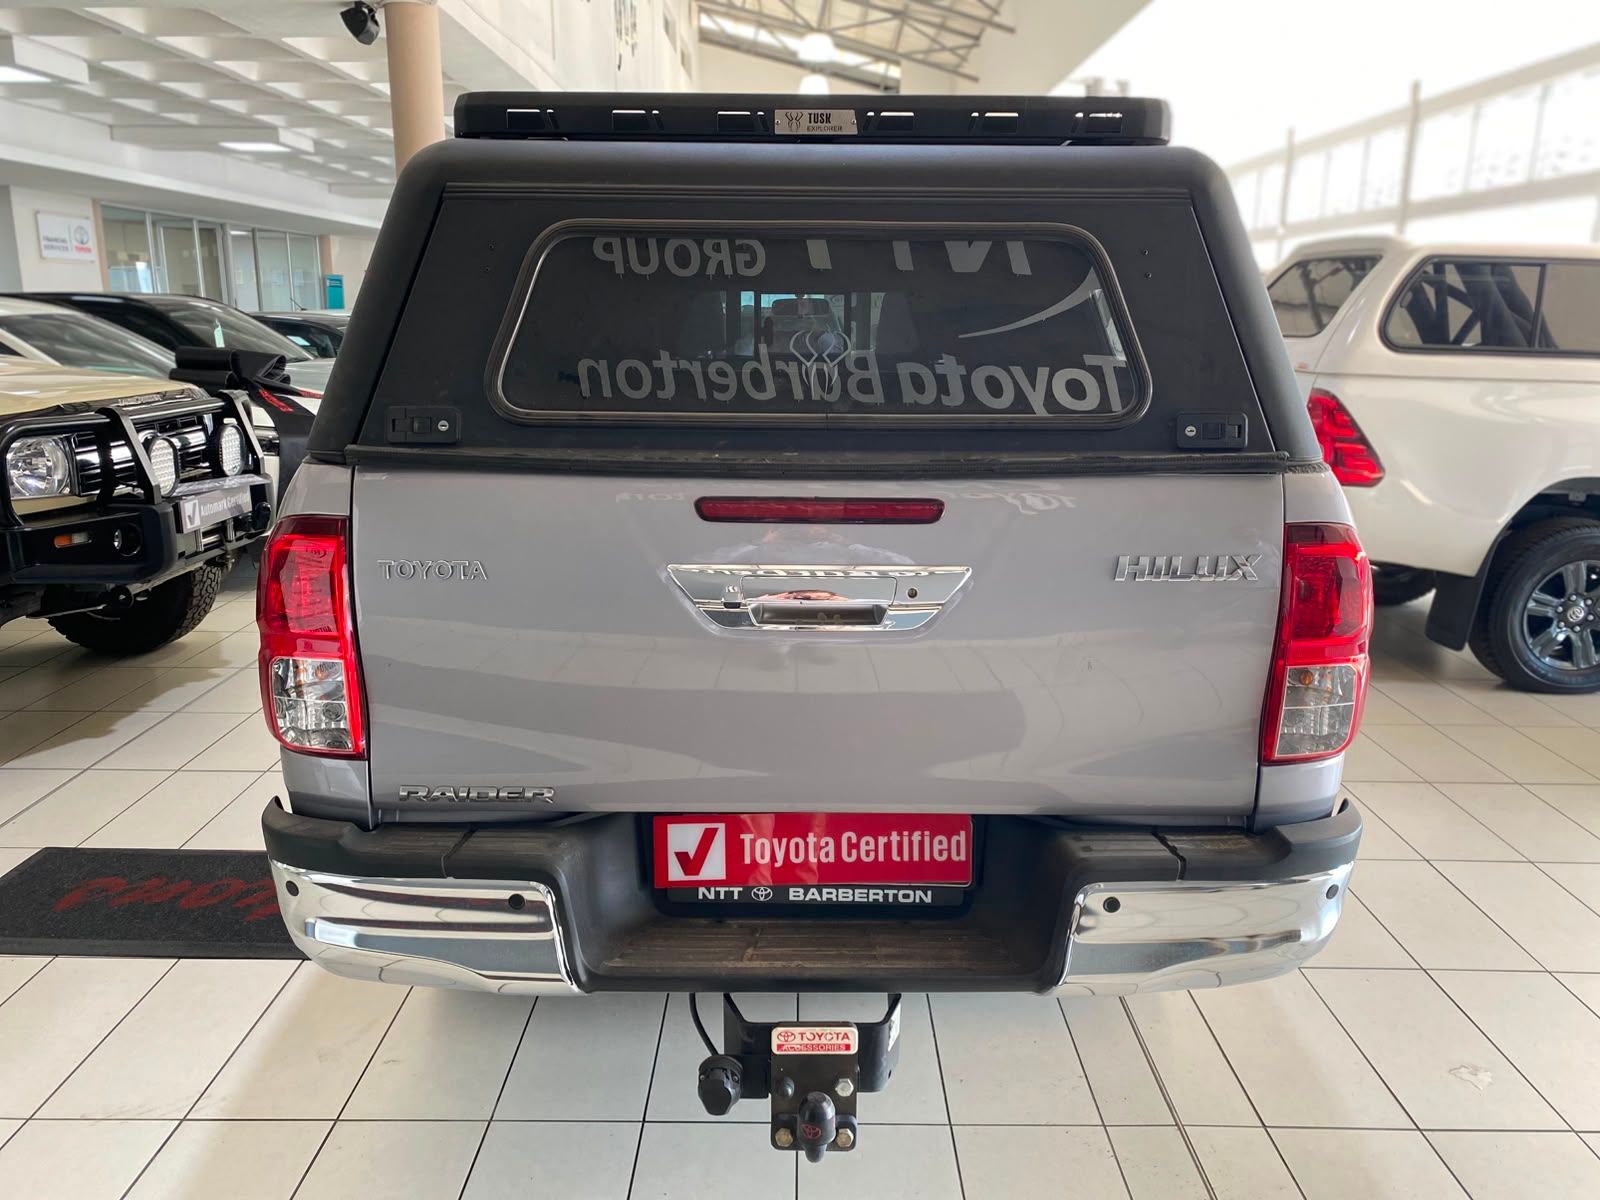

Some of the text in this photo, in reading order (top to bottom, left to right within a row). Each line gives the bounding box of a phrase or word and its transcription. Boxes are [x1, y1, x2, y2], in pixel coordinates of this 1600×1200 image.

[807, 112, 831, 124] TUSK
[376, 559, 488, 580] TOYOTA
[1114, 553, 1263, 582] HILUX
[399, 785, 555, 803] RAIDER
[739, 830, 966, 867] Toyota Certified
[698, 887, 932, 903] NTT BARBERTON
[798, 1032, 850, 1041] TOYOTA
